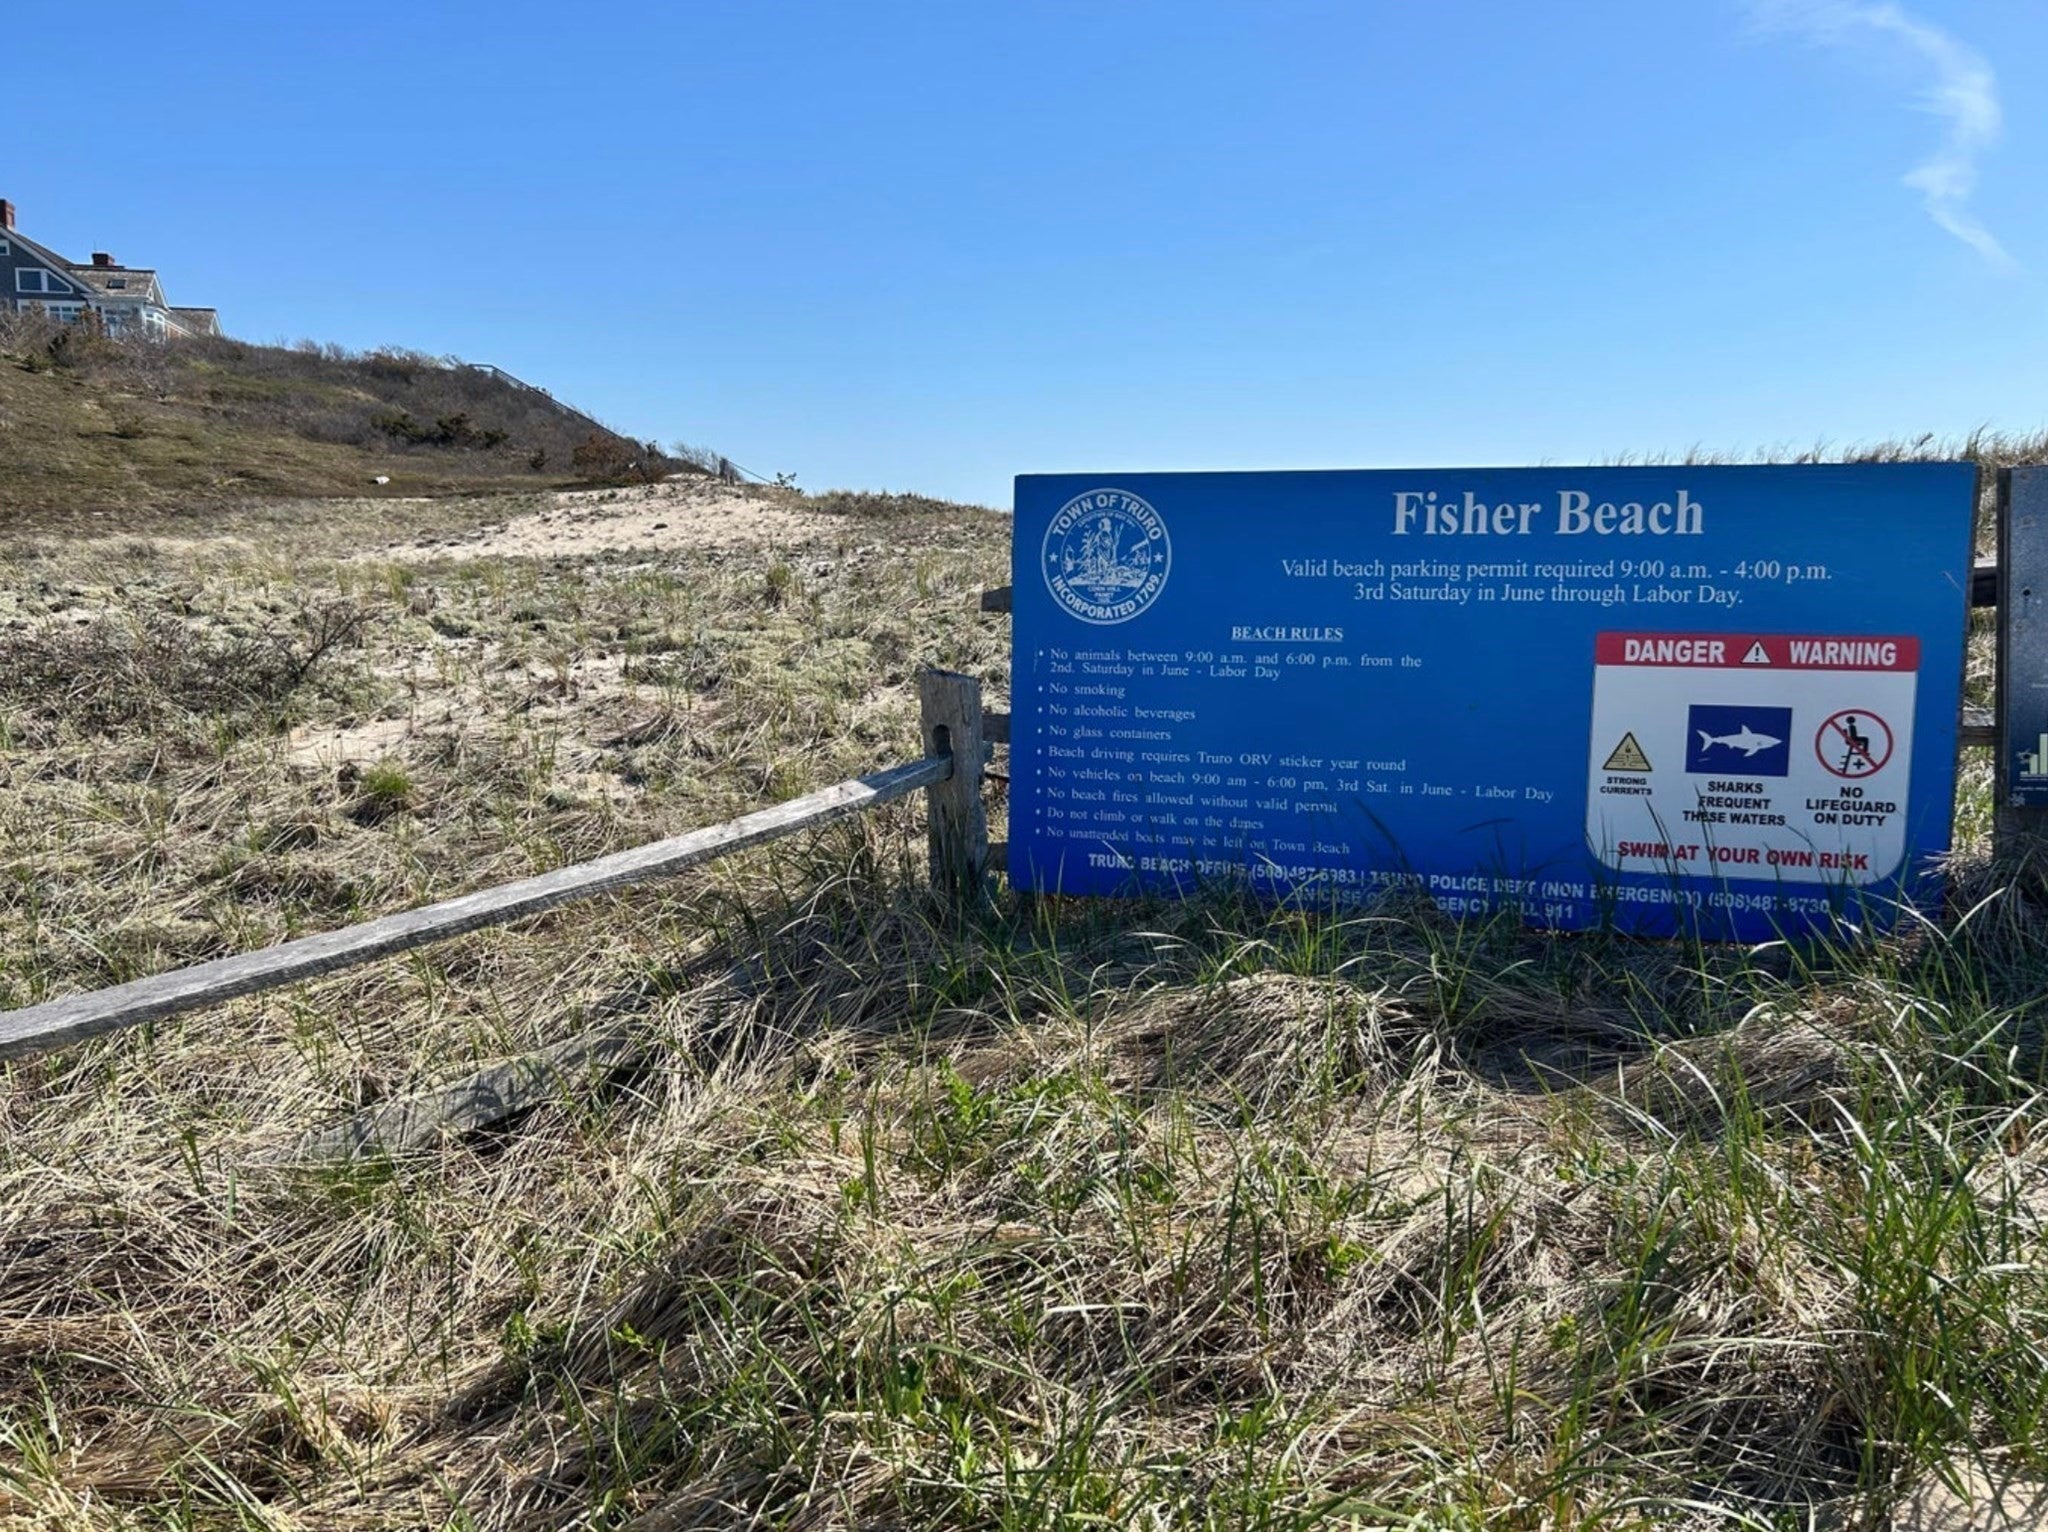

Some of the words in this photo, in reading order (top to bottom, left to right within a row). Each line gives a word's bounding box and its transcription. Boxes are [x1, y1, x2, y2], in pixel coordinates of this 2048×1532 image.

[1052, 498, 1093, 536] TOWN
[1097, 494, 1118, 507] OF
[1121, 497, 1161, 540] TRURO
[1390, 491, 1542, 535] Fisher
[1555, 490, 1704, 534] Beach
[1282, 560, 1327, 577] Valid
[1334, 560, 1384, 577] beach
[1391, 560, 1460, 581] parking
[1466, 560, 1528, 581] permit
[1534, 560, 1614, 581] required
[1620, 561, 1664, 578] 9:00
[1670, 564, 1712, 578] a.m.
[1734, 562, 1780, 579] 4:00
[1786, 567, 1832, 583] p.m.
[1052, 575, 1136, 619] INCORPORATED
[1354, 583, 1384, 600] 3rd
[1390, 583, 1471, 604] Saturday
[1478, 583, 1495, 600] in
[1501, 584, 1544, 601] June
[1552, 585, 1625, 607] through
[1633, 585, 1691, 602] Labor
[1700, 585, 1743, 607] Day.
[1232, 626, 1285, 641] BEACH
[1292, 627, 1343, 641] RULES
[1050, 649, 1068, 660] No
[1075, 650, 1120, 661] animals
[1128, 651, 1178, 662] between
[1185, 652, 1213, 663] 9:00
[1221, 654, 1247, 663] a.m.
[1255, 653, 1278, 664] and
[1286, 653, 1315, 665] 6:00
[1323, 655, 1351, 668] p.m.
[1361, 654, 1393, 666] from
[1401, 655, 1421, 667] the
[1625, 640, 1725, 663] DANGER
[1790, 641, 1896, 666] WARNING
[1050, 662, 1075, 673] 2nd.
[1082, 663, 1134, 677] Saturday
[1142, 665, 1153, 675] in
[1161, 665, 1188, 676] June
[1210, 665, 1247, 677] Labor
[1255, 666, 1280, 681] Day
[1050, 684, 1067, 693] No
[1074, 684, 1125, 699] smoking
[1050, 705, 1067, 715] No
[1074, 706, 1128, 717] alcoholic
[1135, 707, 1195, 721] beverages
[1050, 725, 1066, 735] No
[1073, 726, 1103, 739] glass
[1110, 728, 1171, 740] containers
[1049, 746, 1084, 757] Beach
[1091, 747, 1134, 762] driving
[1142, 751, 1190, 763] requires
[1198, 752, 1232, 764] Truro
[1239, 754, 1272, 765] ORV
[1279, 755, 1323, 767] sticker
[1330, 760, 1359, 771] year
[1367, 760, 1406, 771] round
[1049, 767, 1066, 777] No
[1073, 768, 1120, 780] vehicles
[1128, 773, 1142, 781] on
[1150, 771, 1185, 784] beach
[1192, 773, 1220, 785] 9:00
[1227, 778, 1246, 786] am
[1267, 777, 1296, 788] 6:00
[1337, 779, 1358, 791] 3rd
[1366, 781, 1390, 793] Sat.
[1400, 782, 1413, 794] in
[1421, 783, 1452, 796] June
[1475, 786, 1517, 798] Labor
[1525, 787, 1553, 803] Day
[1607, 776, 1647, 785] STRONG
[1708, 781, 1763, 793] SHARKS
[1600, 786, 1652, 795] CURRENTS
[1840, 787, 1863, 798] NO
[1048, 788, 1065, 799] No
[1072, 789, 1105, 800] beach
[1113, 790, 1138, 803] fires
[1146, 793, 1193, 805] allowed
[1201, 795, 1248, 808] without
[1256, 798, 1287, 810] valid
[1295, 800, 1338, 814] permit
[1699, 796, 1771, 810] FREQUENT
[1806, 799, 1896, 813] LIFEGUARD
[1048, 808, 1063, 818] Do
[1070, 810, 1087, 820] not
[1094, 810, 1125, 821] climb
[1131, 814, 1142, 822] or
[1150, 813, 1176, 824] walk
[1183, 817, 1198, 825] on
[1205, 816, 1222, 827] the
[1229, 817, 1264, 829] dunes
[1683, 811, 1726, 823] THESE
[1731, 813, 1785, 826] WATERS
[1814, 813, 1836, 824] ON
[1843, 814, 1886, 826] DUTY
[1048, 827, 1063, 837] No
[1070, 829, 1129, 841] unattended
[1172, 836, 1195, 847] may
[1203, 836, 1217, 846] be
[1251, 841, 1265, 849] on
[1274, 839, 1305, 852] Town
[1618, 841, 1668, 858] SWIM
[1675, 845, 1699, 860] AT
[1707, 846, 1759, 864] YOUR
[1767, 850, 1812, 866] OWN
[1820, 853, 1868, 870] RISK
[1141, 857, 1189, 872] BEACH
[1430, 875, 1488, 892] POLICE
[1542, 881, 1583, 898] (NON
[1545, 902, 1573, 918] 911
